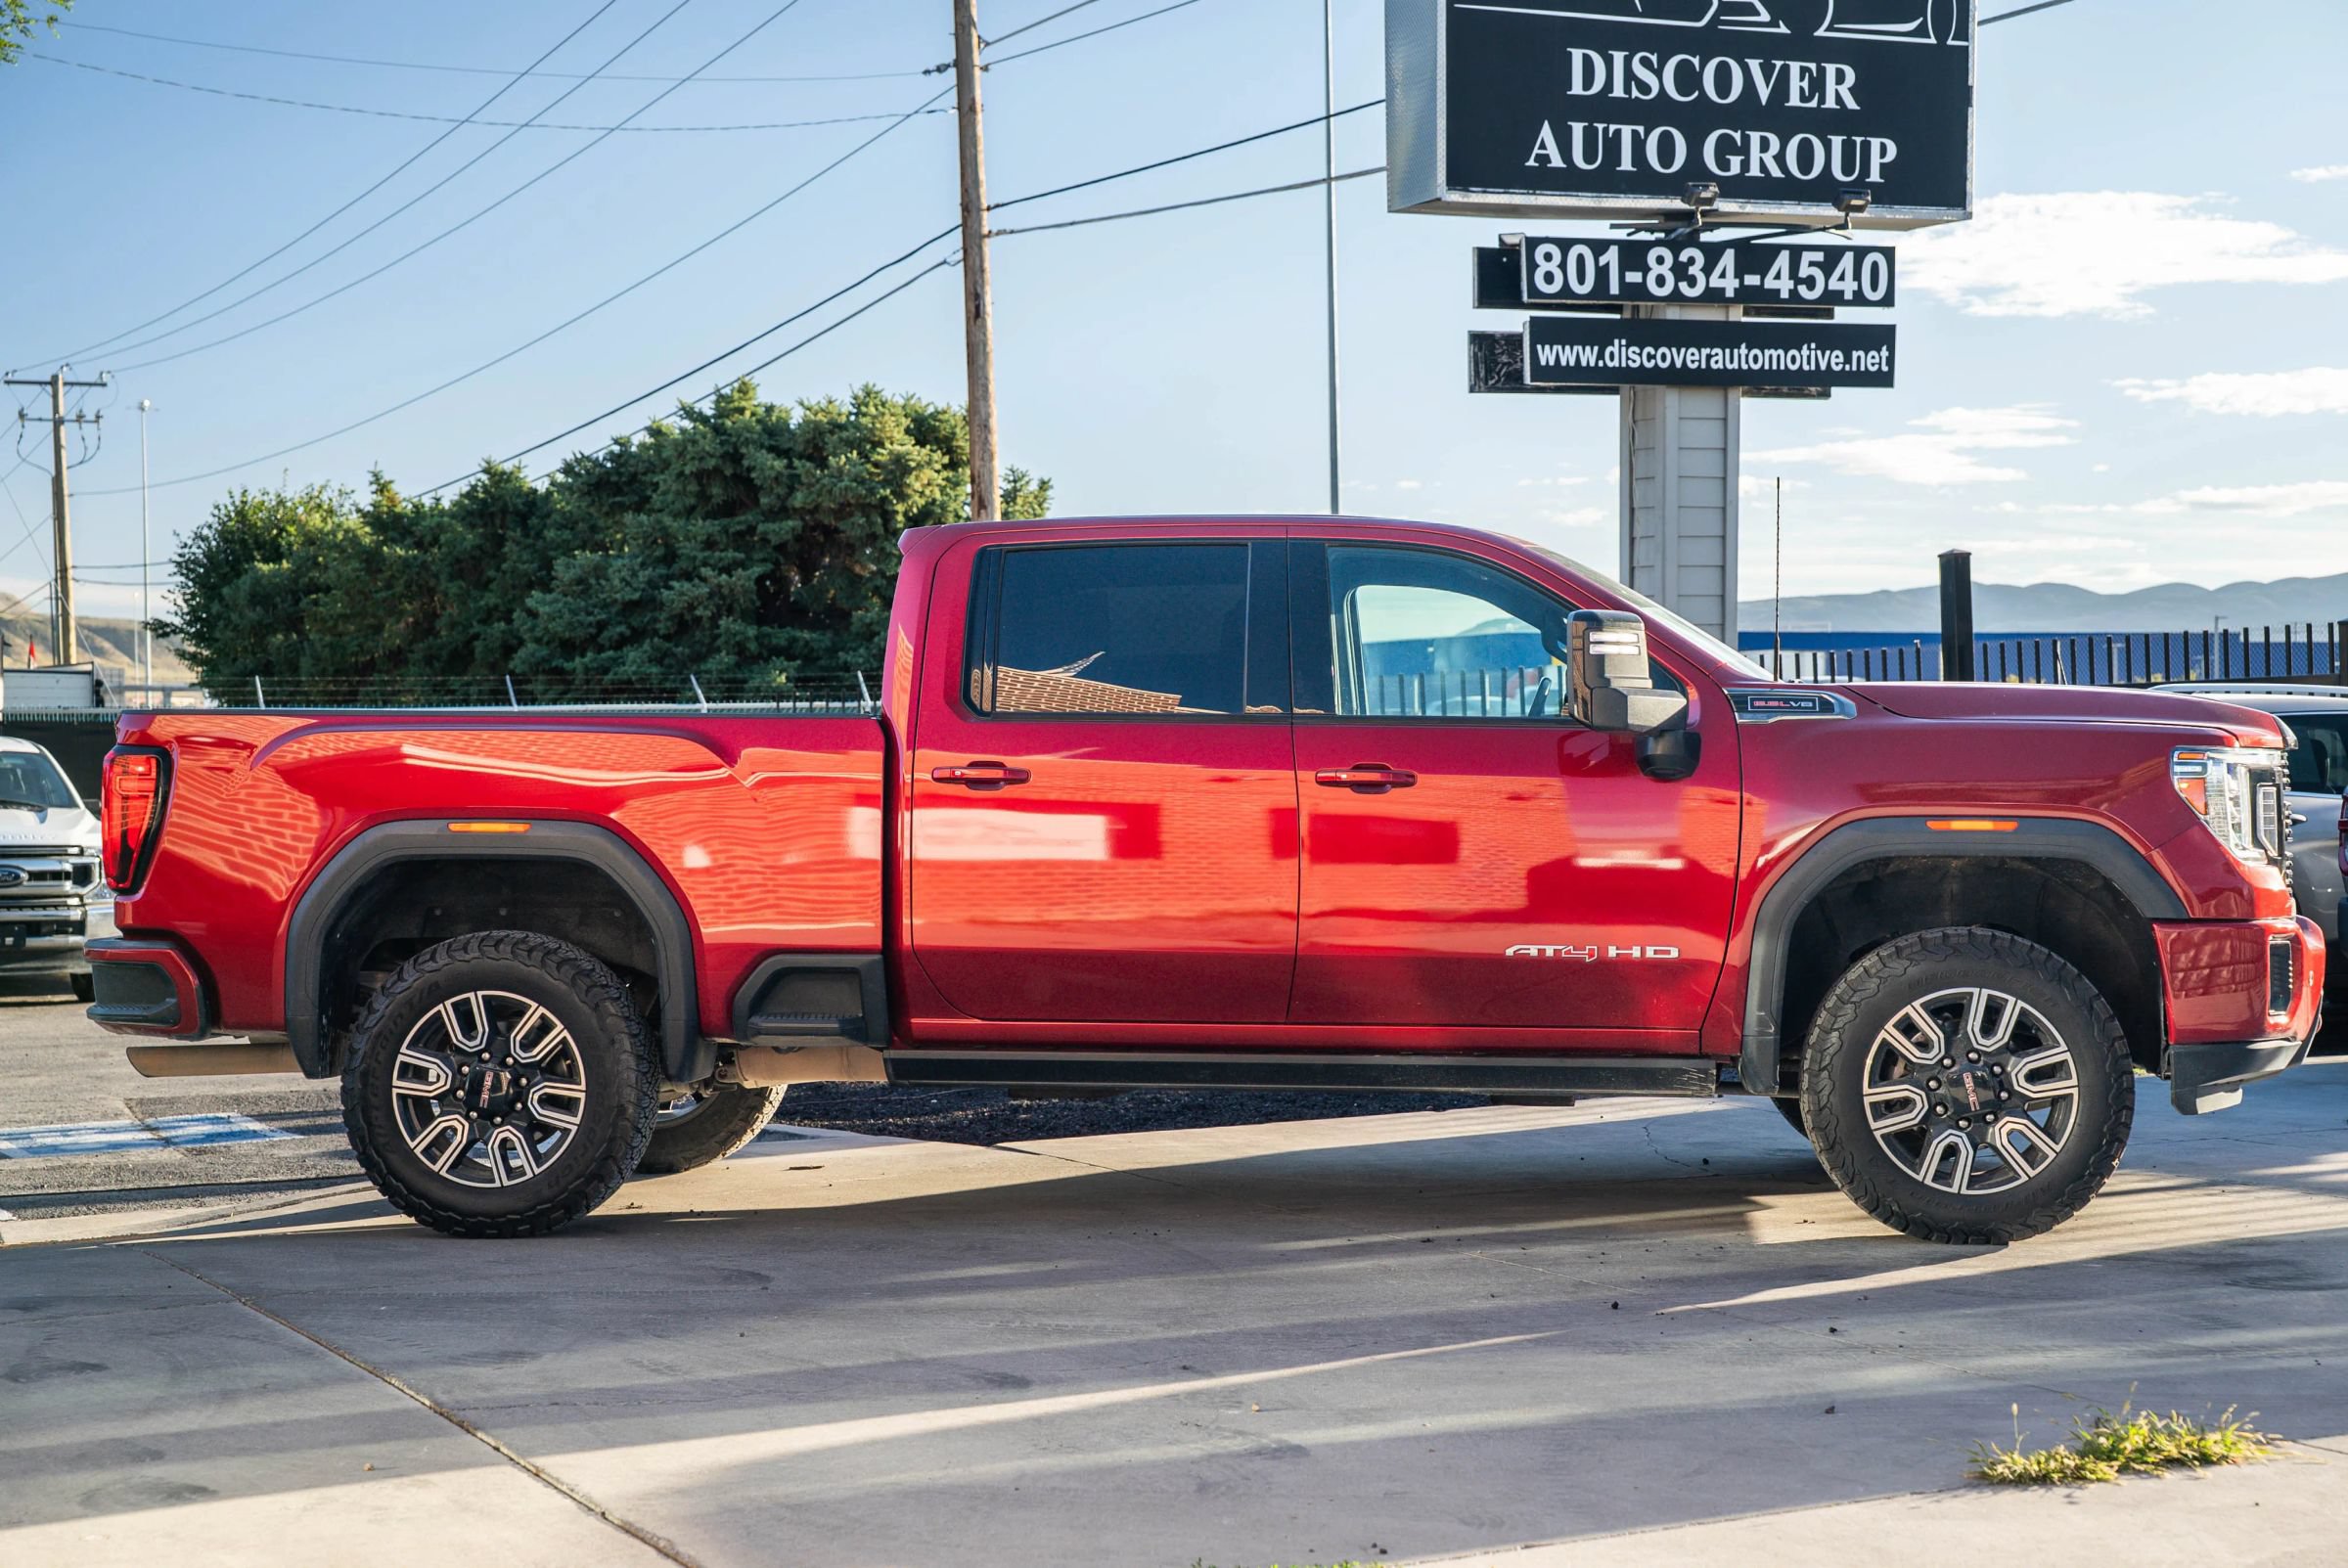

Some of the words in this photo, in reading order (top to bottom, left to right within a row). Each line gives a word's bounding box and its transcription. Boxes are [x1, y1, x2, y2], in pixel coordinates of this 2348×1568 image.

[1566, 47, 1861, 111] DISCOVER
[1524, 119, 1688, 174] AUTO
[1702, 128, 1898, 183] GROUP
[1533, 243, 1889, 301] 801-834-4540
[1536, 338, 1889, 373] www.discoverautomotive.net
[1505, 944, 1598, 963] AT4
[1607, 945, 1679, 960] HD
[478, 1071, 494, 1108] GMC
[1963, 1072, 1980, 1111] GMC
